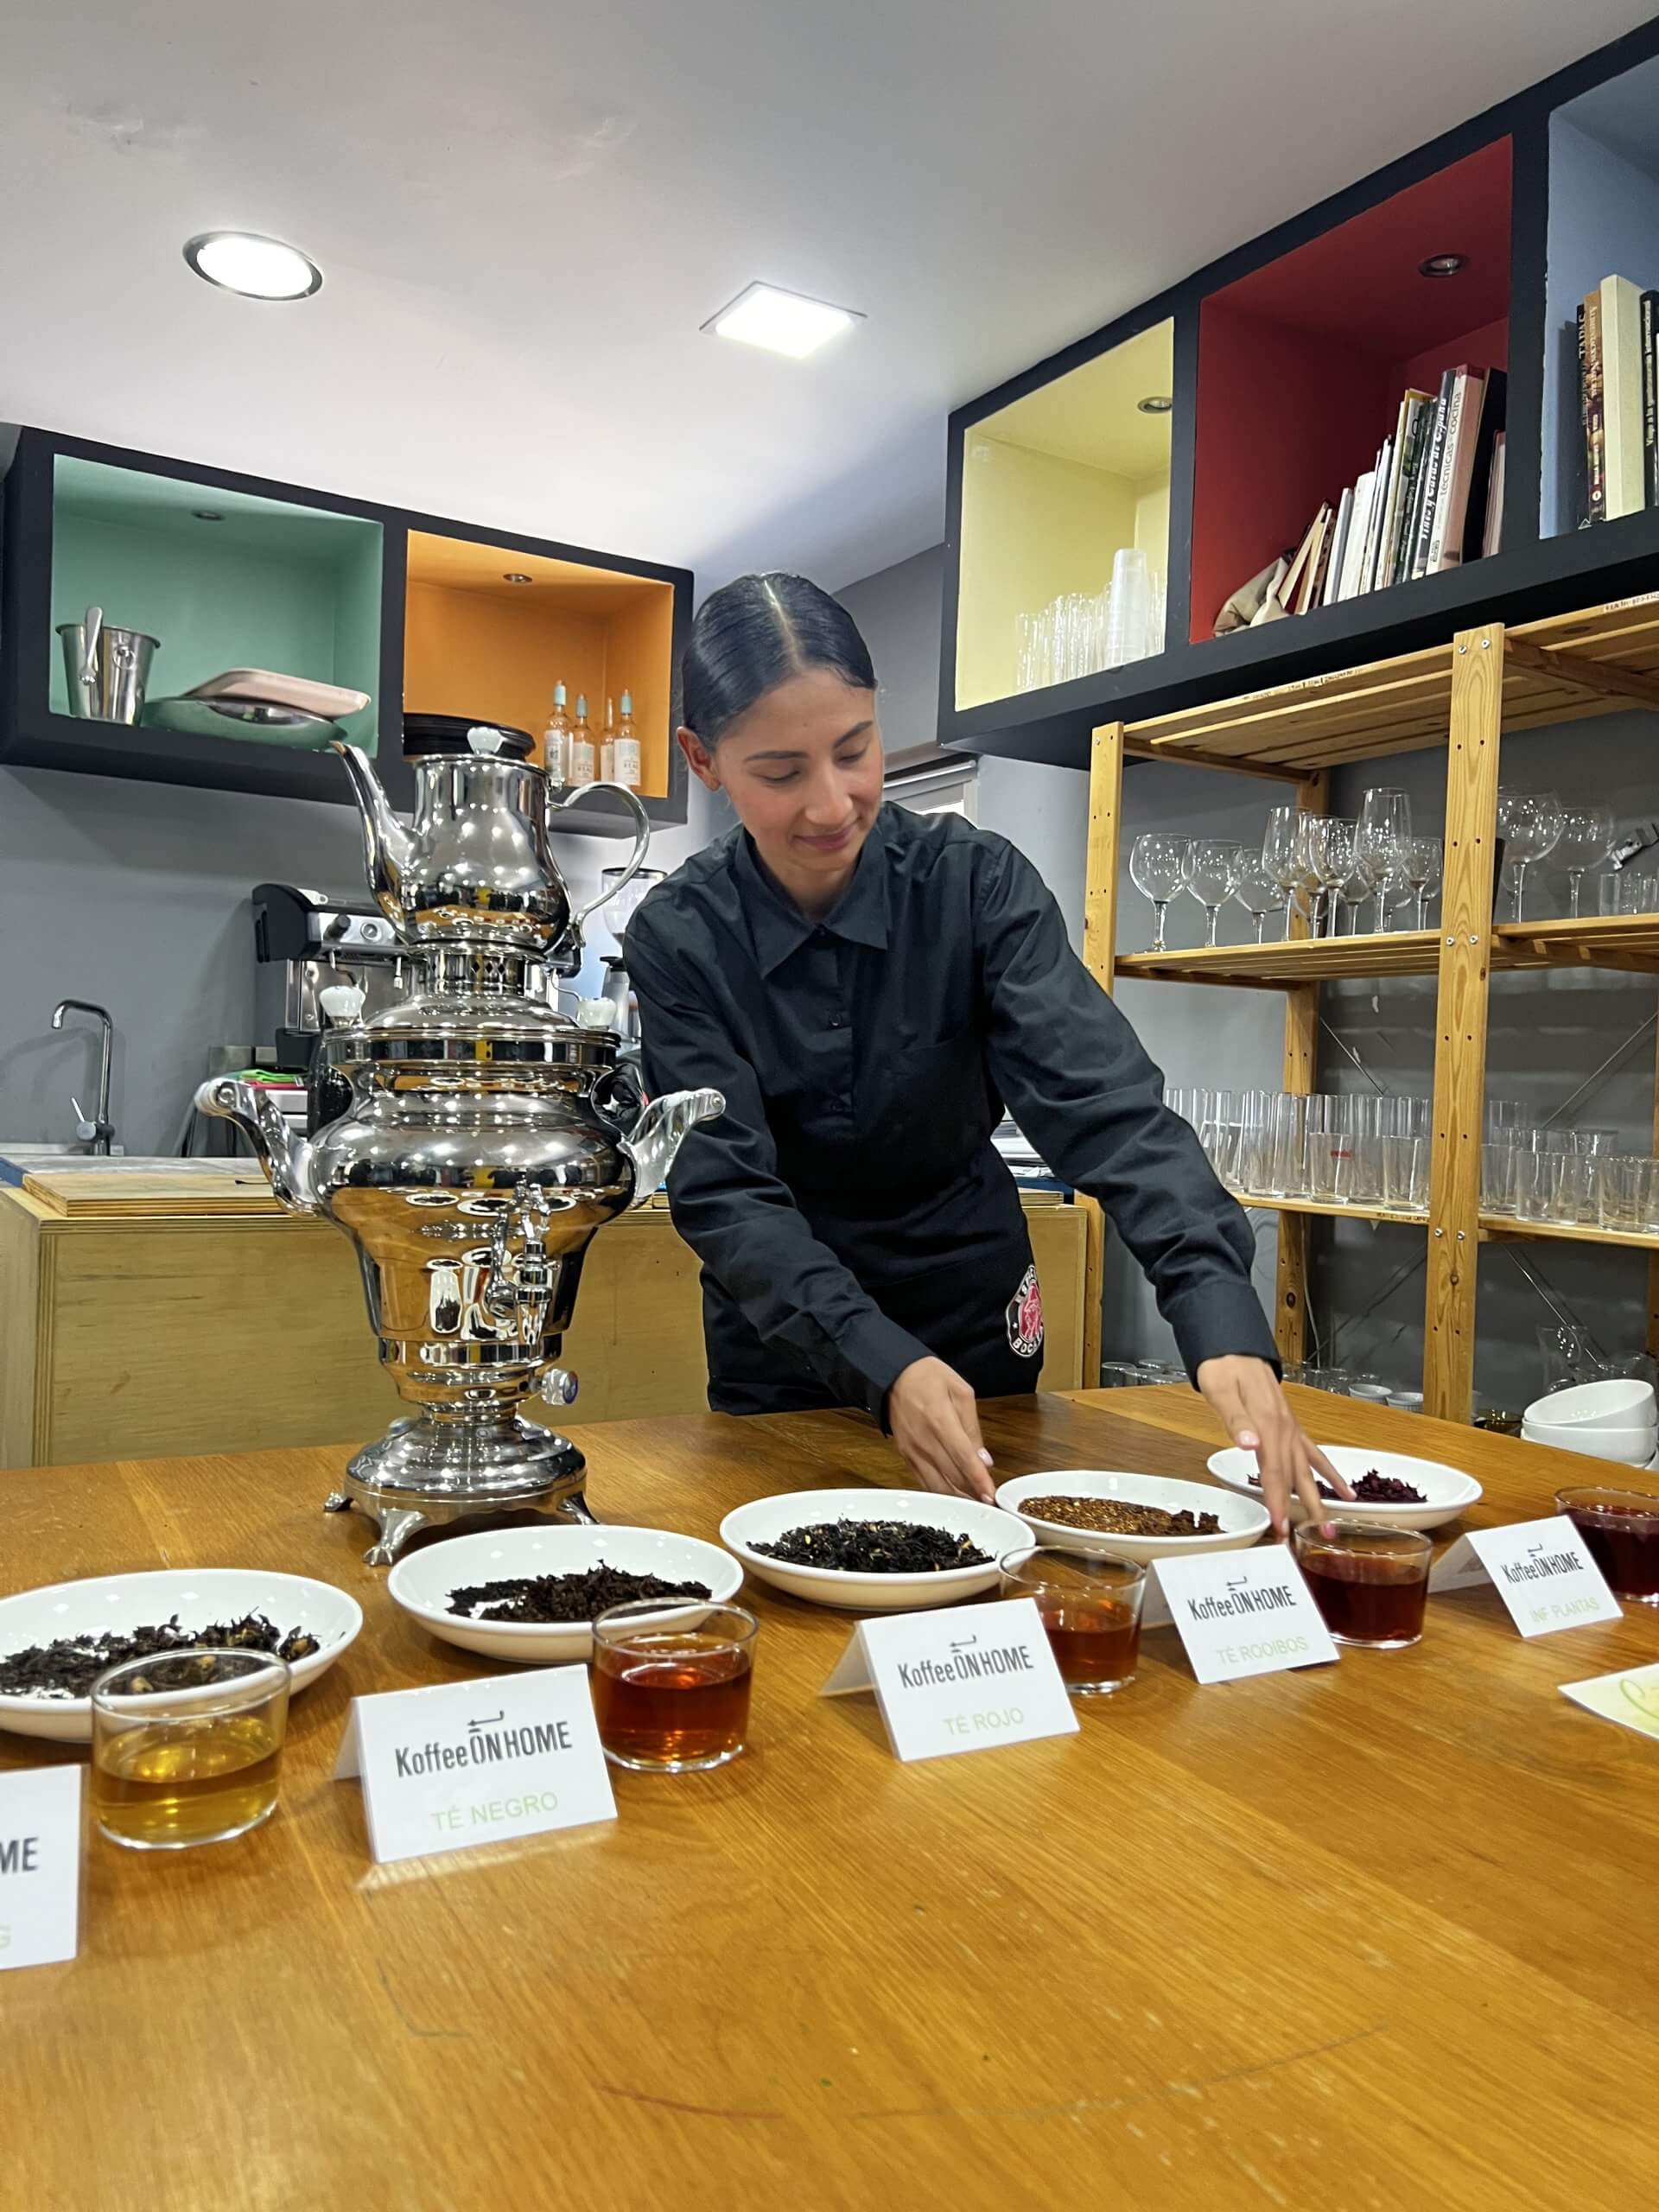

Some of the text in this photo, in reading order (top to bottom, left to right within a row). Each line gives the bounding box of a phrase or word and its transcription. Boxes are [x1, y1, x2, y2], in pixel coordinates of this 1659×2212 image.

[1500, 1562, 1539, 1584] Koffee
[1547, 1552, 1584, 1575] HOME
[1187, 1596, 1235, 1621] Koffee
[1250, 1586, 1297, 1611] HOME
[1551, 1596, 1599, 1618] PLANTAS
[1240, 1636, 1309, 1661] ROOIBOS
[897, 1659, 956, 1689] Koffee
[980, 1645, 1034, 1675] HOME
[943, 1707, 1025, 1735] TÉ ROJO
[395, 1742, 469, 1777] Koffee
[503, 1721, 573, 1758] HOME
[431, 1791, 559, 1831] TÉ NEGRO
